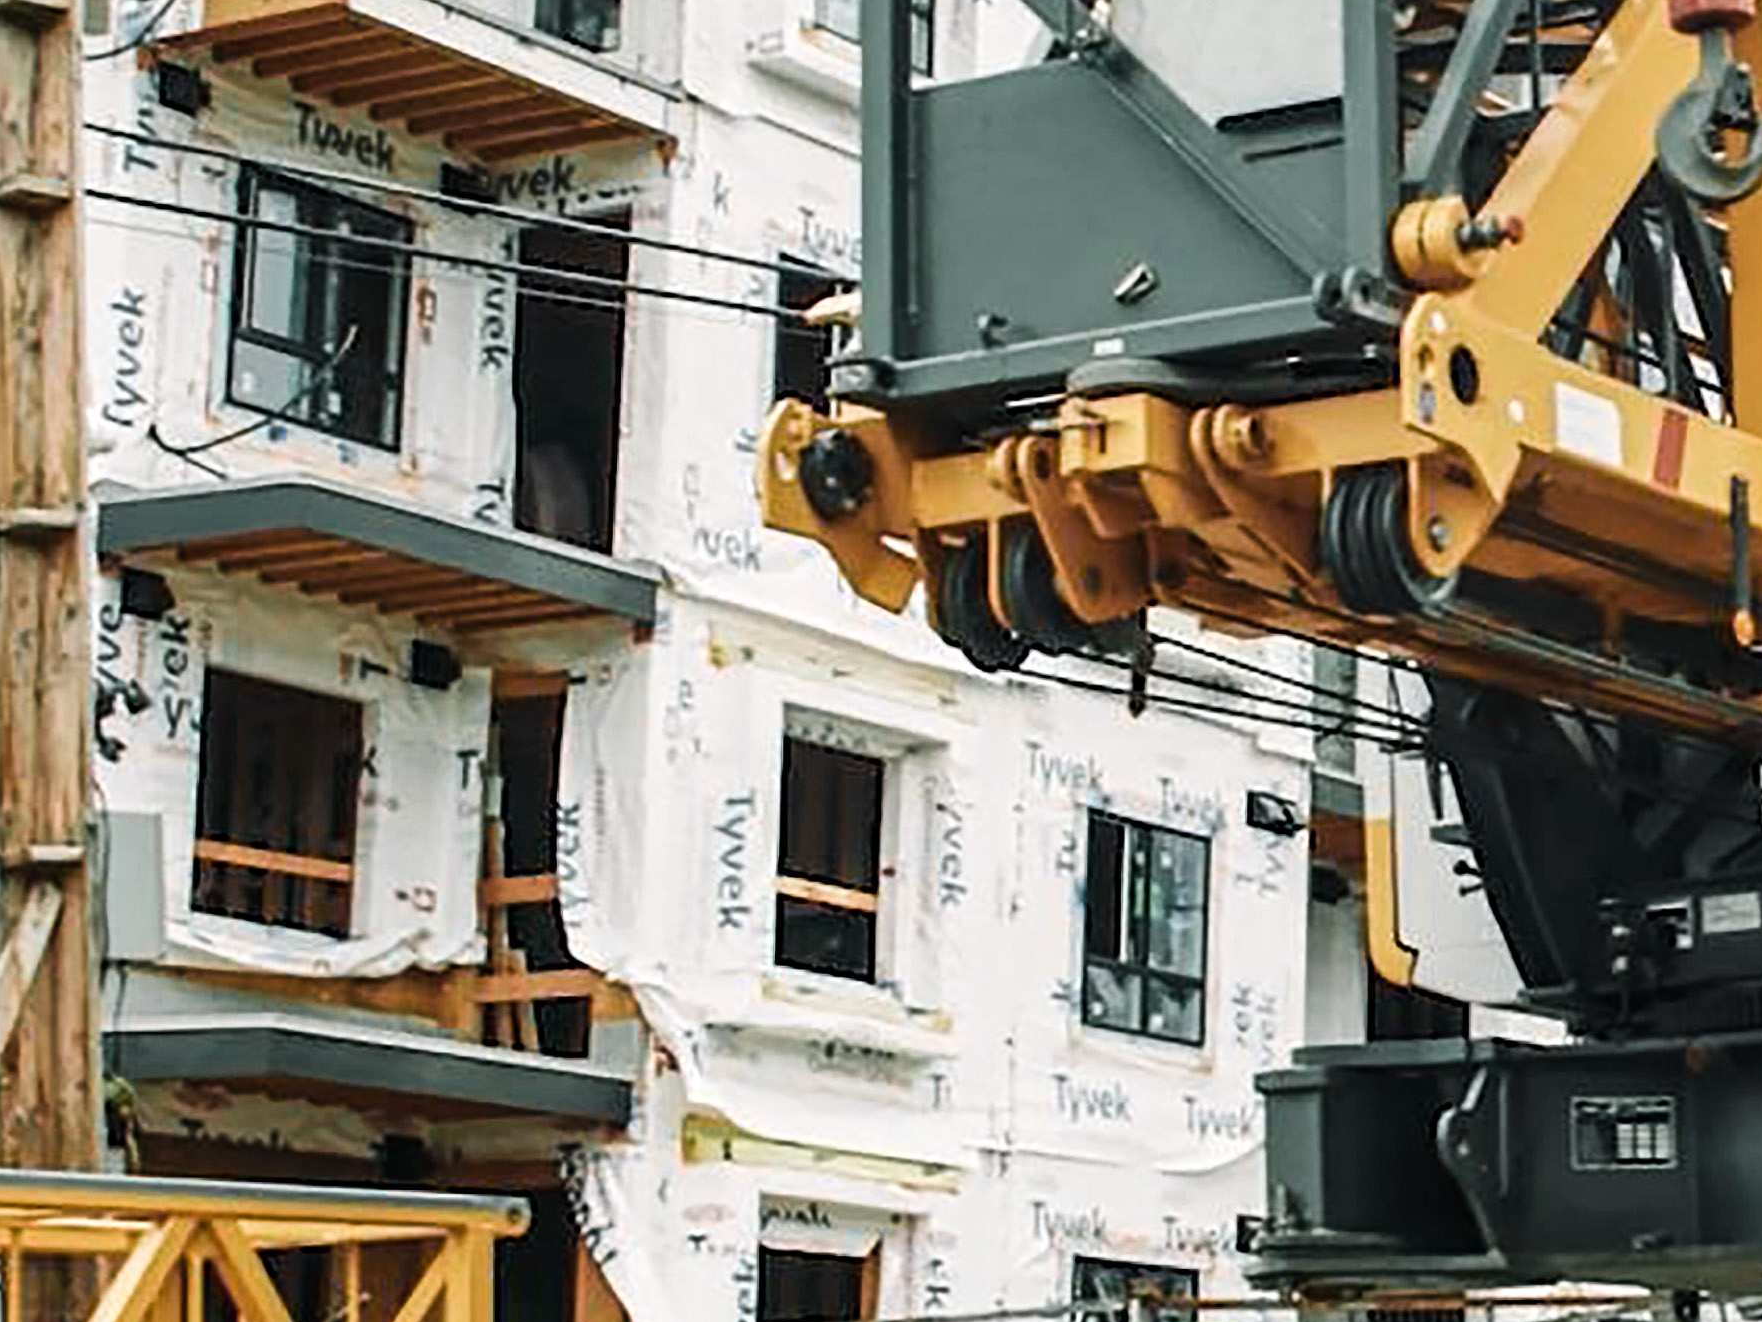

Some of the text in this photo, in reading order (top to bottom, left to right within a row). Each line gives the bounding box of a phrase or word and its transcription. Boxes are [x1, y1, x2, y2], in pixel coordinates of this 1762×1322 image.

[104, 286, 145, 427] Tyvek
[1025, 741, 1105, 792] Tyvek
[715, 790, 756, 931] Tyvek
[935, 801, 968, 908] yvek
[1052, 1073, 1133, 1123] Tyvek
